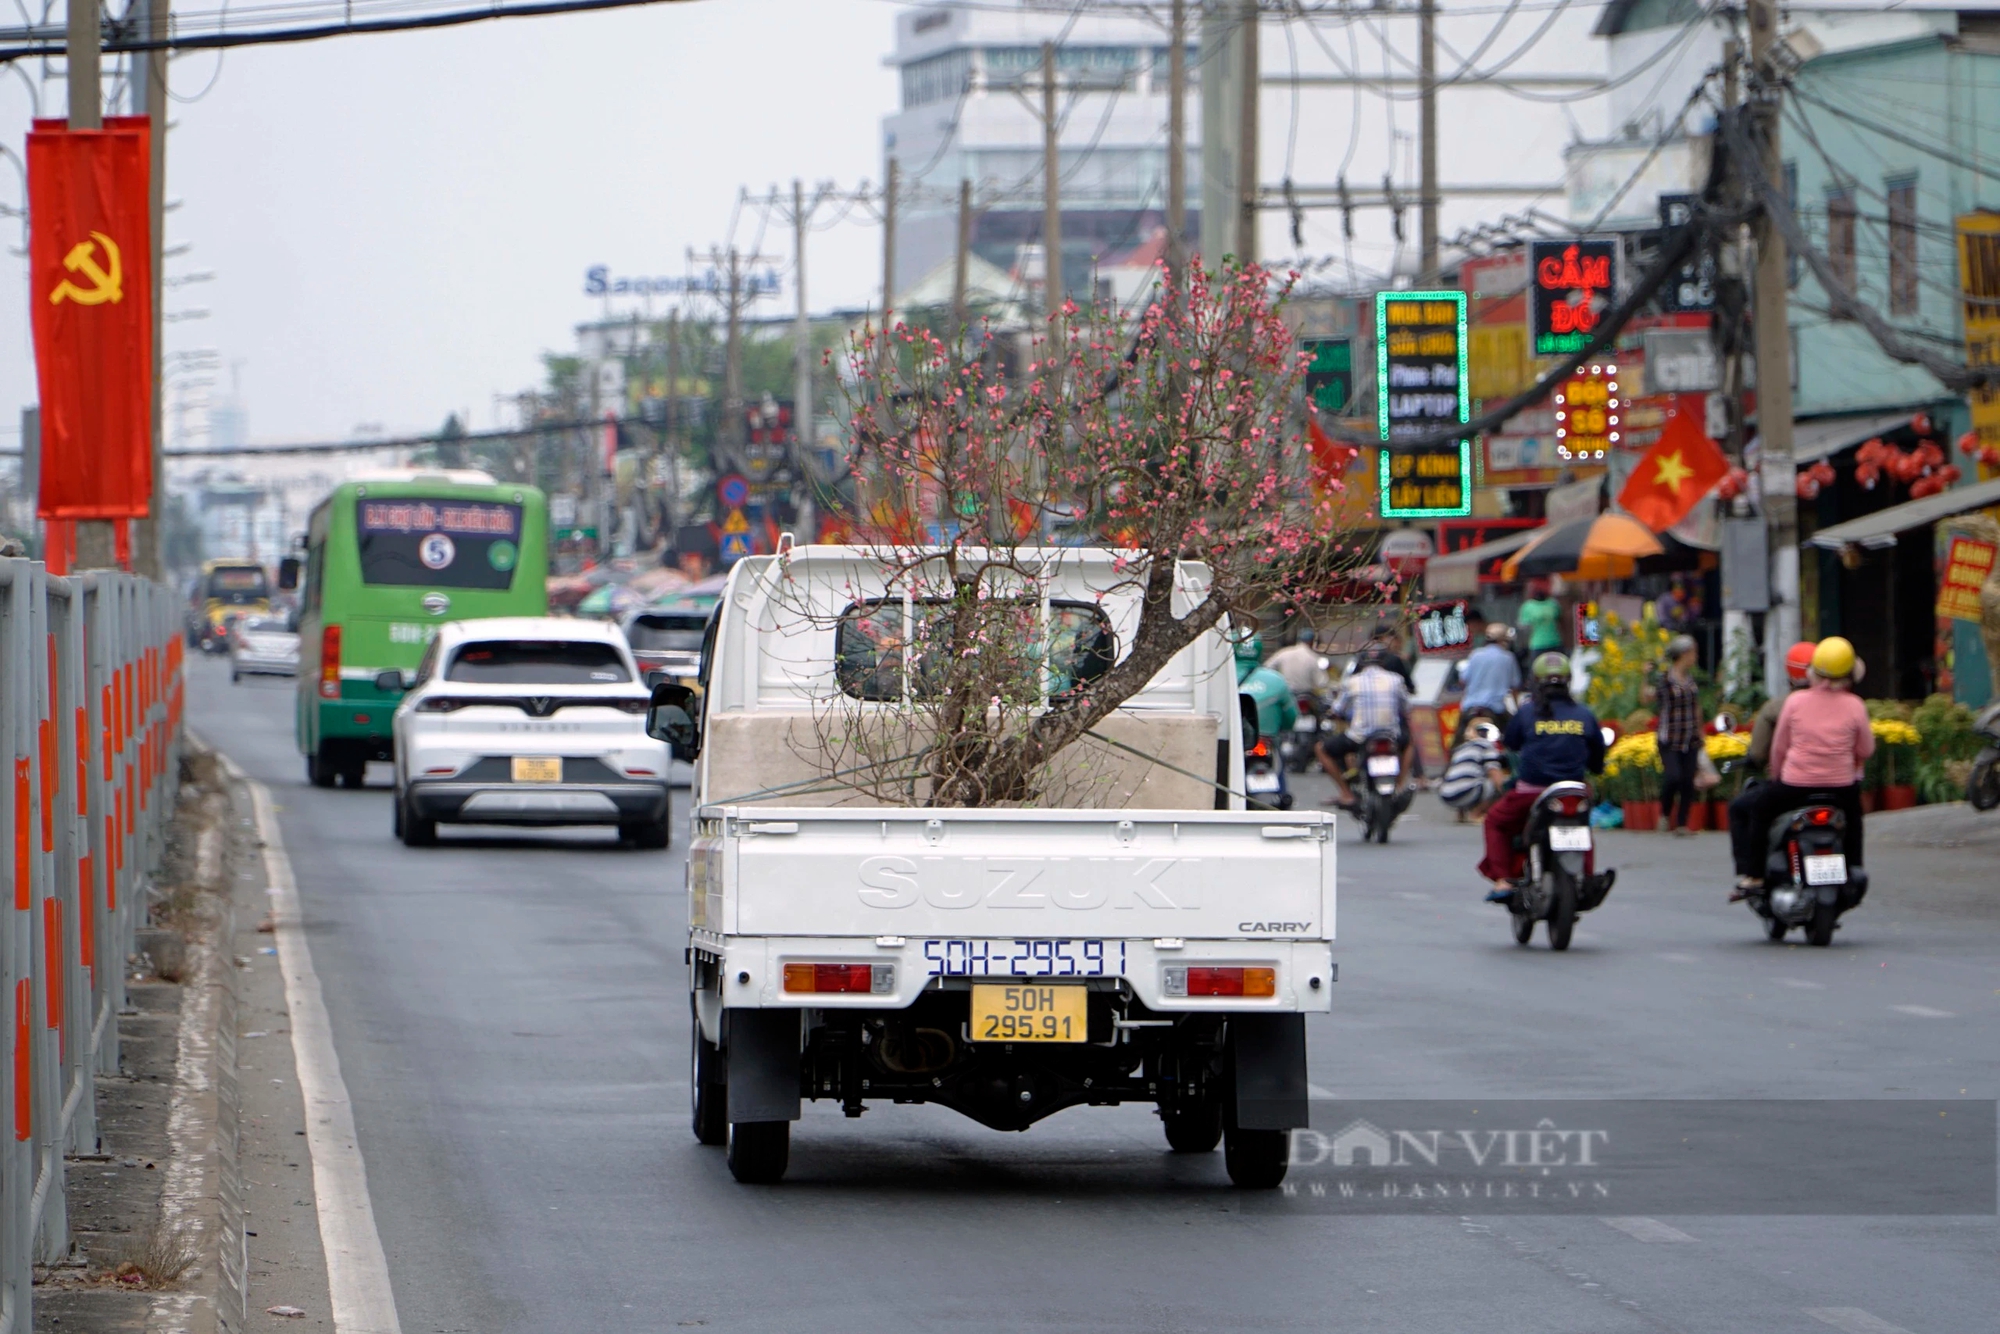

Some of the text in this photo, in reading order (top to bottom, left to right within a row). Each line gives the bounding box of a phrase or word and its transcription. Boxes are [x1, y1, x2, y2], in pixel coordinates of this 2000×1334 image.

[429, 540, 445, 563] 5
[1534, 720, 1584, 735] POLICE
[857, 855, 1201, 910] SUZUKI
[1238, 921, 1312, 934] CARRY
[925, 941, 1126, 975] 50H-295.91
[1005, 988, 1054, 1011] 50H
[985, 1015, 1072, 1039] 295.91
